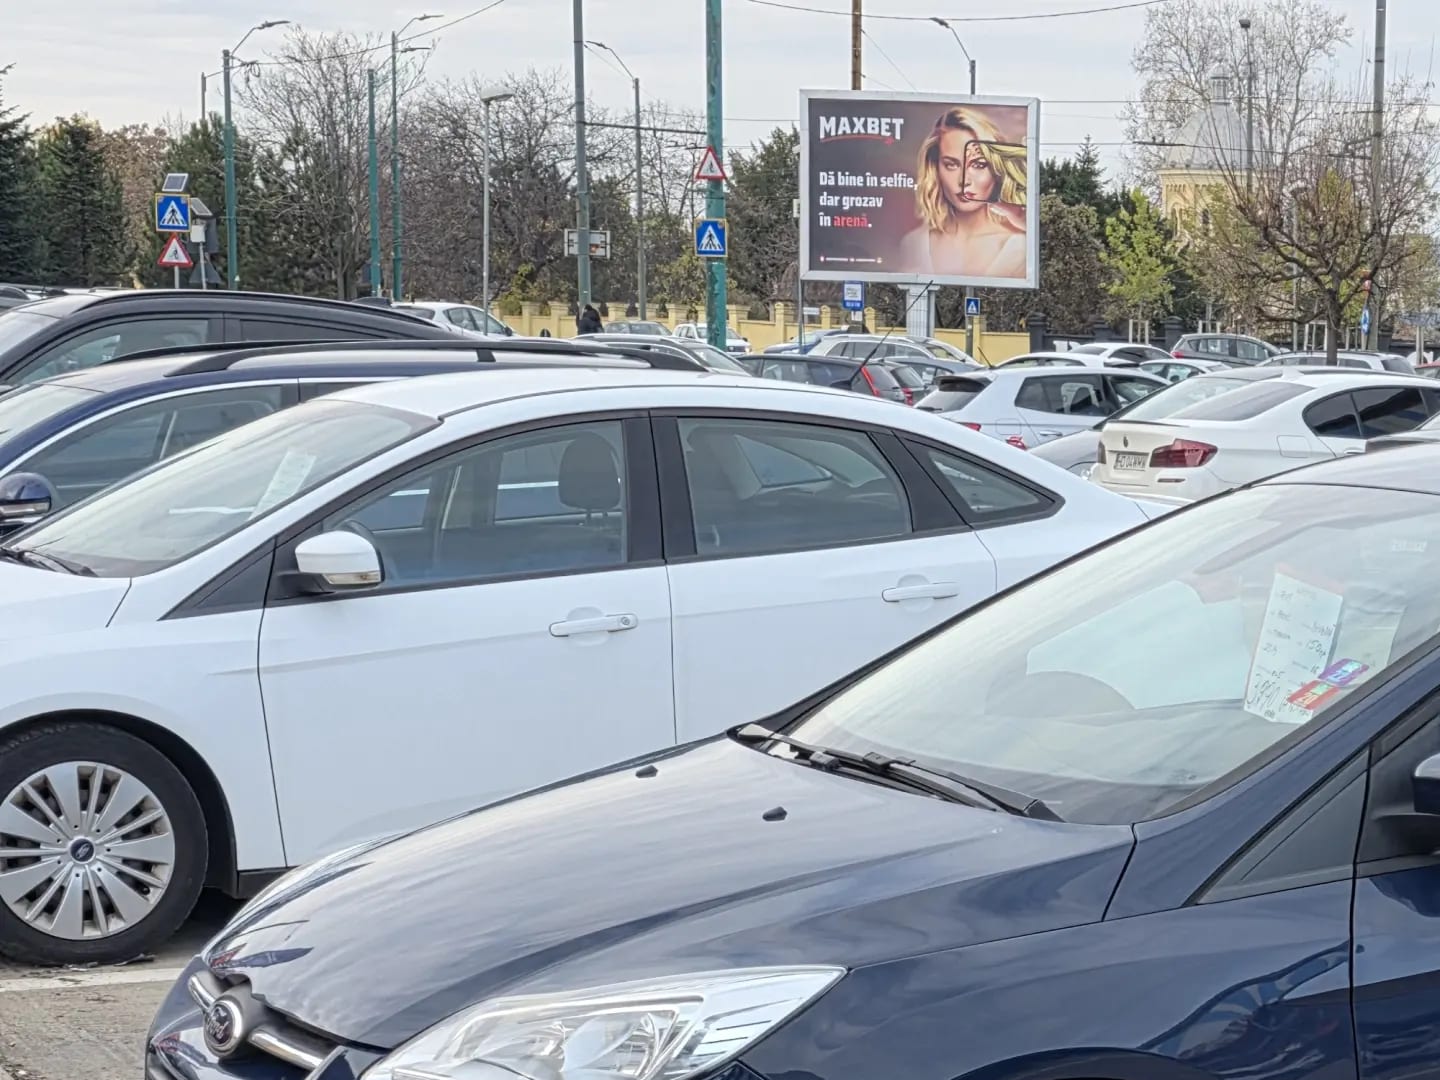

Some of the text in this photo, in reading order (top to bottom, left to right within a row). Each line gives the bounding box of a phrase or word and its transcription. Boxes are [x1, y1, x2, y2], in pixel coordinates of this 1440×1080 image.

[819, 116, 904, 140] MAXBET
[819, 171, 918, 191] Dă bine în selfie,
[819, 191, 883, 210] dar grozav
[818, 211, 832, 227] în
[207, 1006, 230, 1040] Ford
